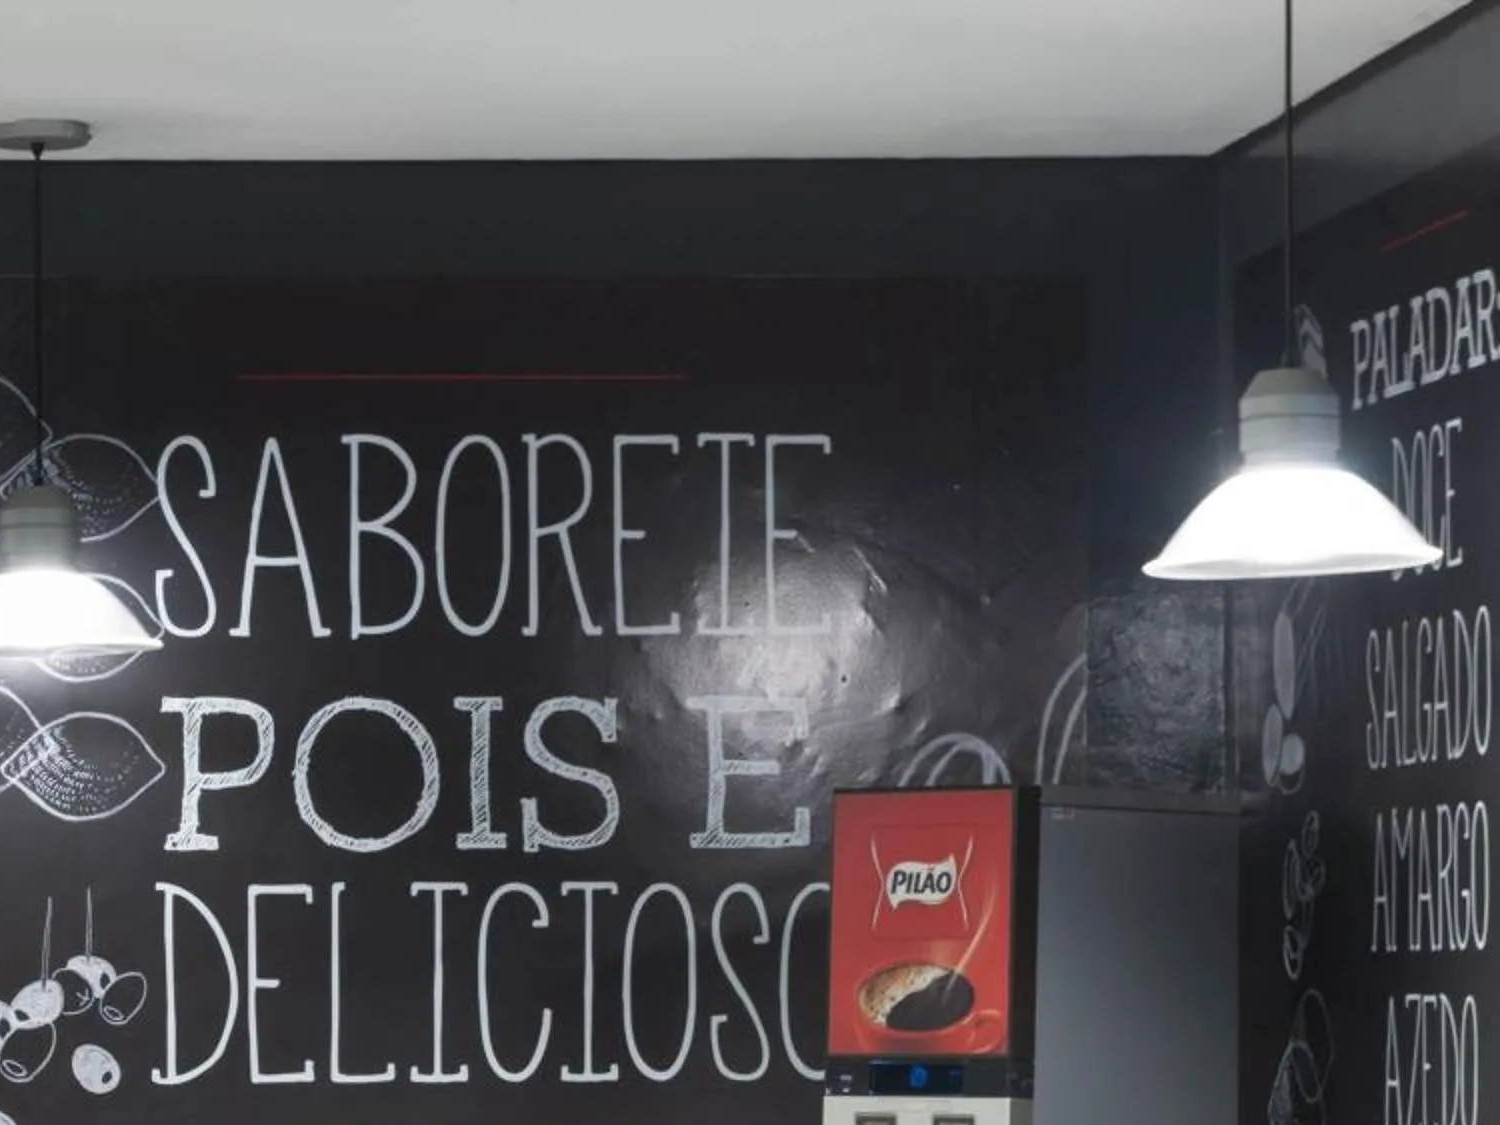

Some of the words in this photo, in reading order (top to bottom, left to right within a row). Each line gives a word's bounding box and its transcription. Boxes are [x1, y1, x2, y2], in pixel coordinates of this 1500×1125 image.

[1391, 417, 1462, 581] DOCE
[1366, 605, 1492, 770] SALGADO
[161, 695, 620, 853] POIS
[1372, 801, 1490, 952] AMARGO
